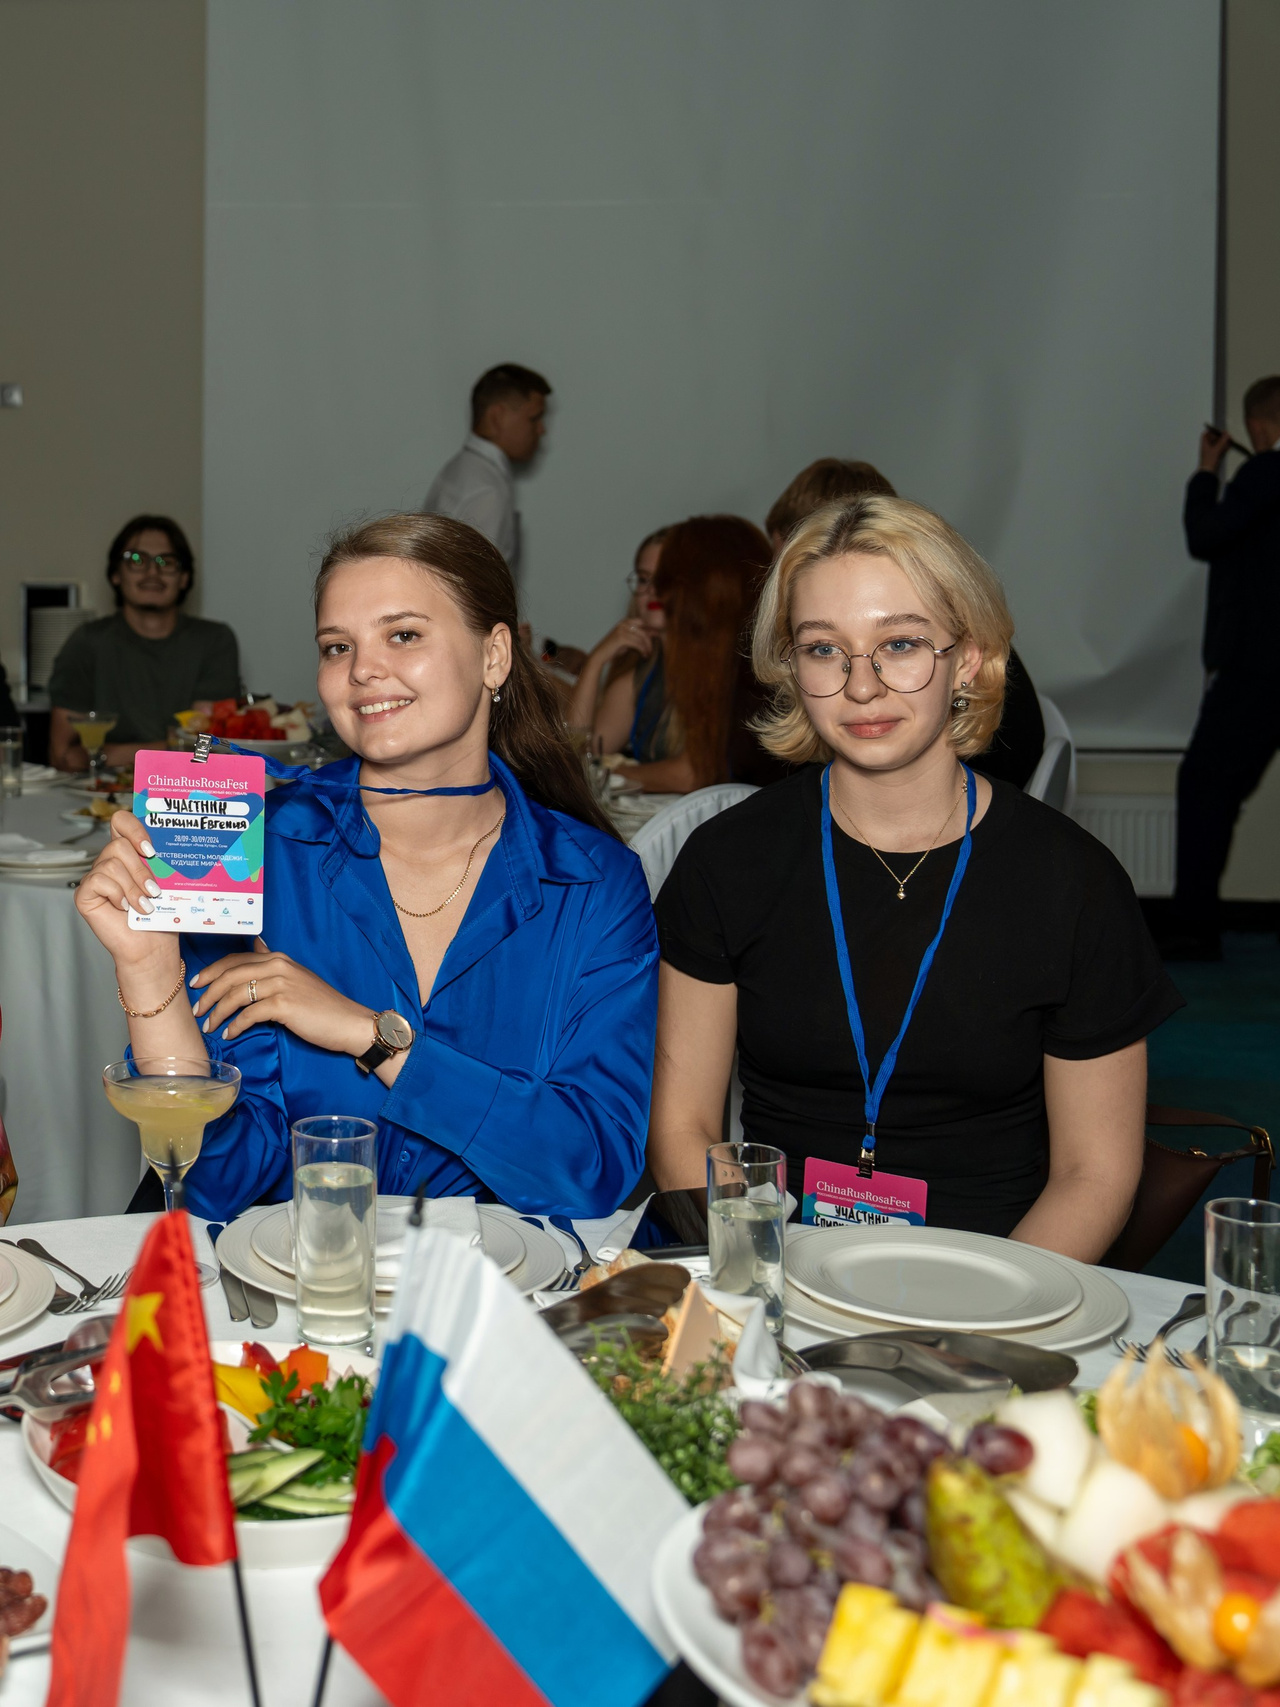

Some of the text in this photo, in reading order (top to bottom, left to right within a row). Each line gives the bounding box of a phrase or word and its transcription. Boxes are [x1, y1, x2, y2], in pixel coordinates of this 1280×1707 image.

[148, 775, 248, 790] ChinaRusRosaFest
[174, 835, 219, 843] 28/09-30/09/2024
[155, 852, 206, 860] ВЕТСТВЕННОСТЬ
[816, 1180, 911, 1208] ChinaRusRosaFest
